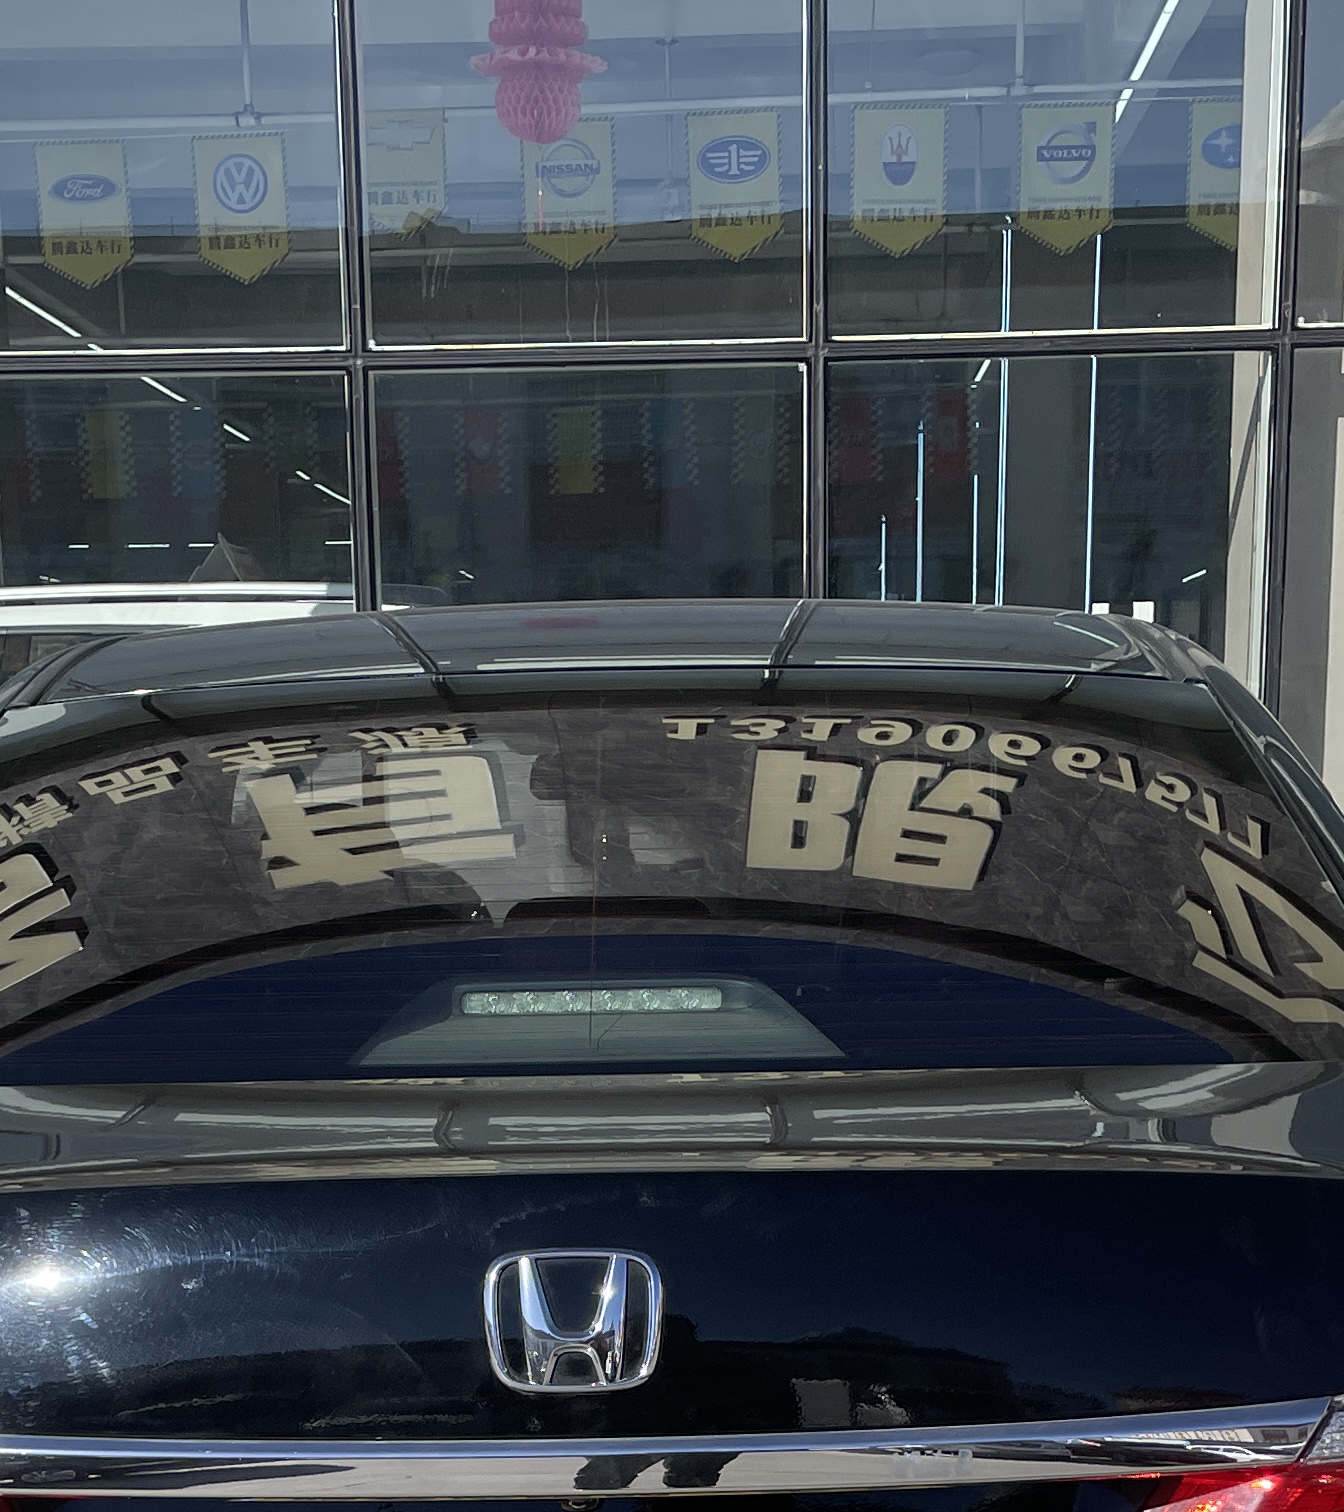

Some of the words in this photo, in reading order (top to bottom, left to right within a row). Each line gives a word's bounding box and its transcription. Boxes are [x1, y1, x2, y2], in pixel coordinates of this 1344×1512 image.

[1041, 148, 1092, 158] VOLVO
[542, 162, 595, 175] NISSAN
[63, 179, 104, 199] Ford
